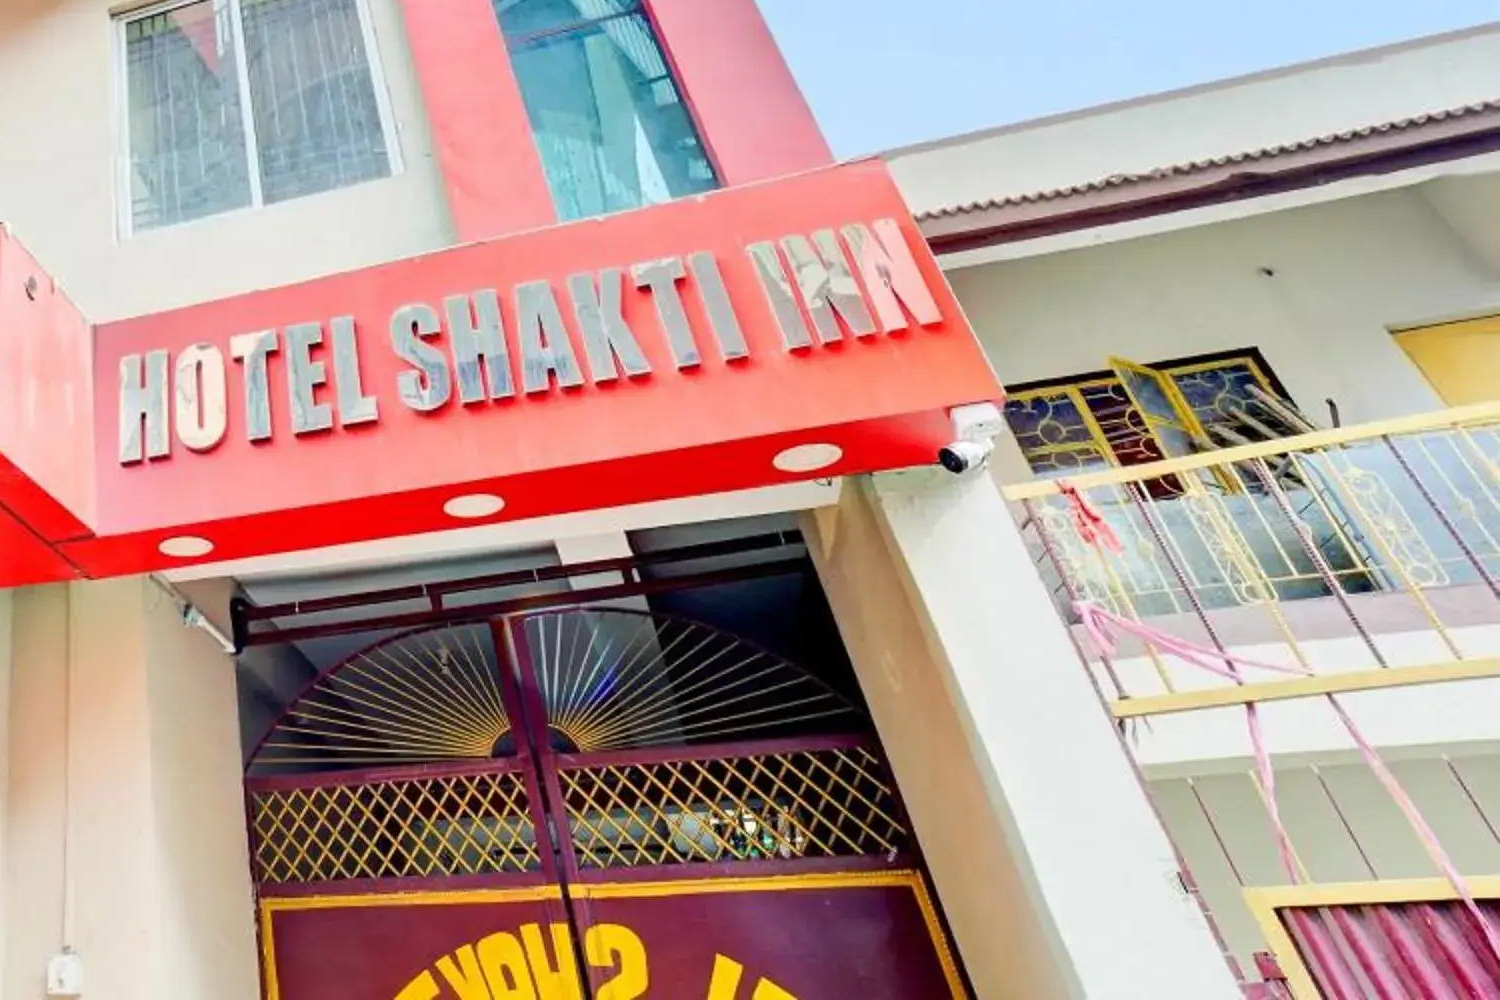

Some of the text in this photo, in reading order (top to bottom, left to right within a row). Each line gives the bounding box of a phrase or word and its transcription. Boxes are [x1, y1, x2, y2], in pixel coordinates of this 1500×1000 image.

[118, 217, 943, 466] HOTEL SHAKTI INN
